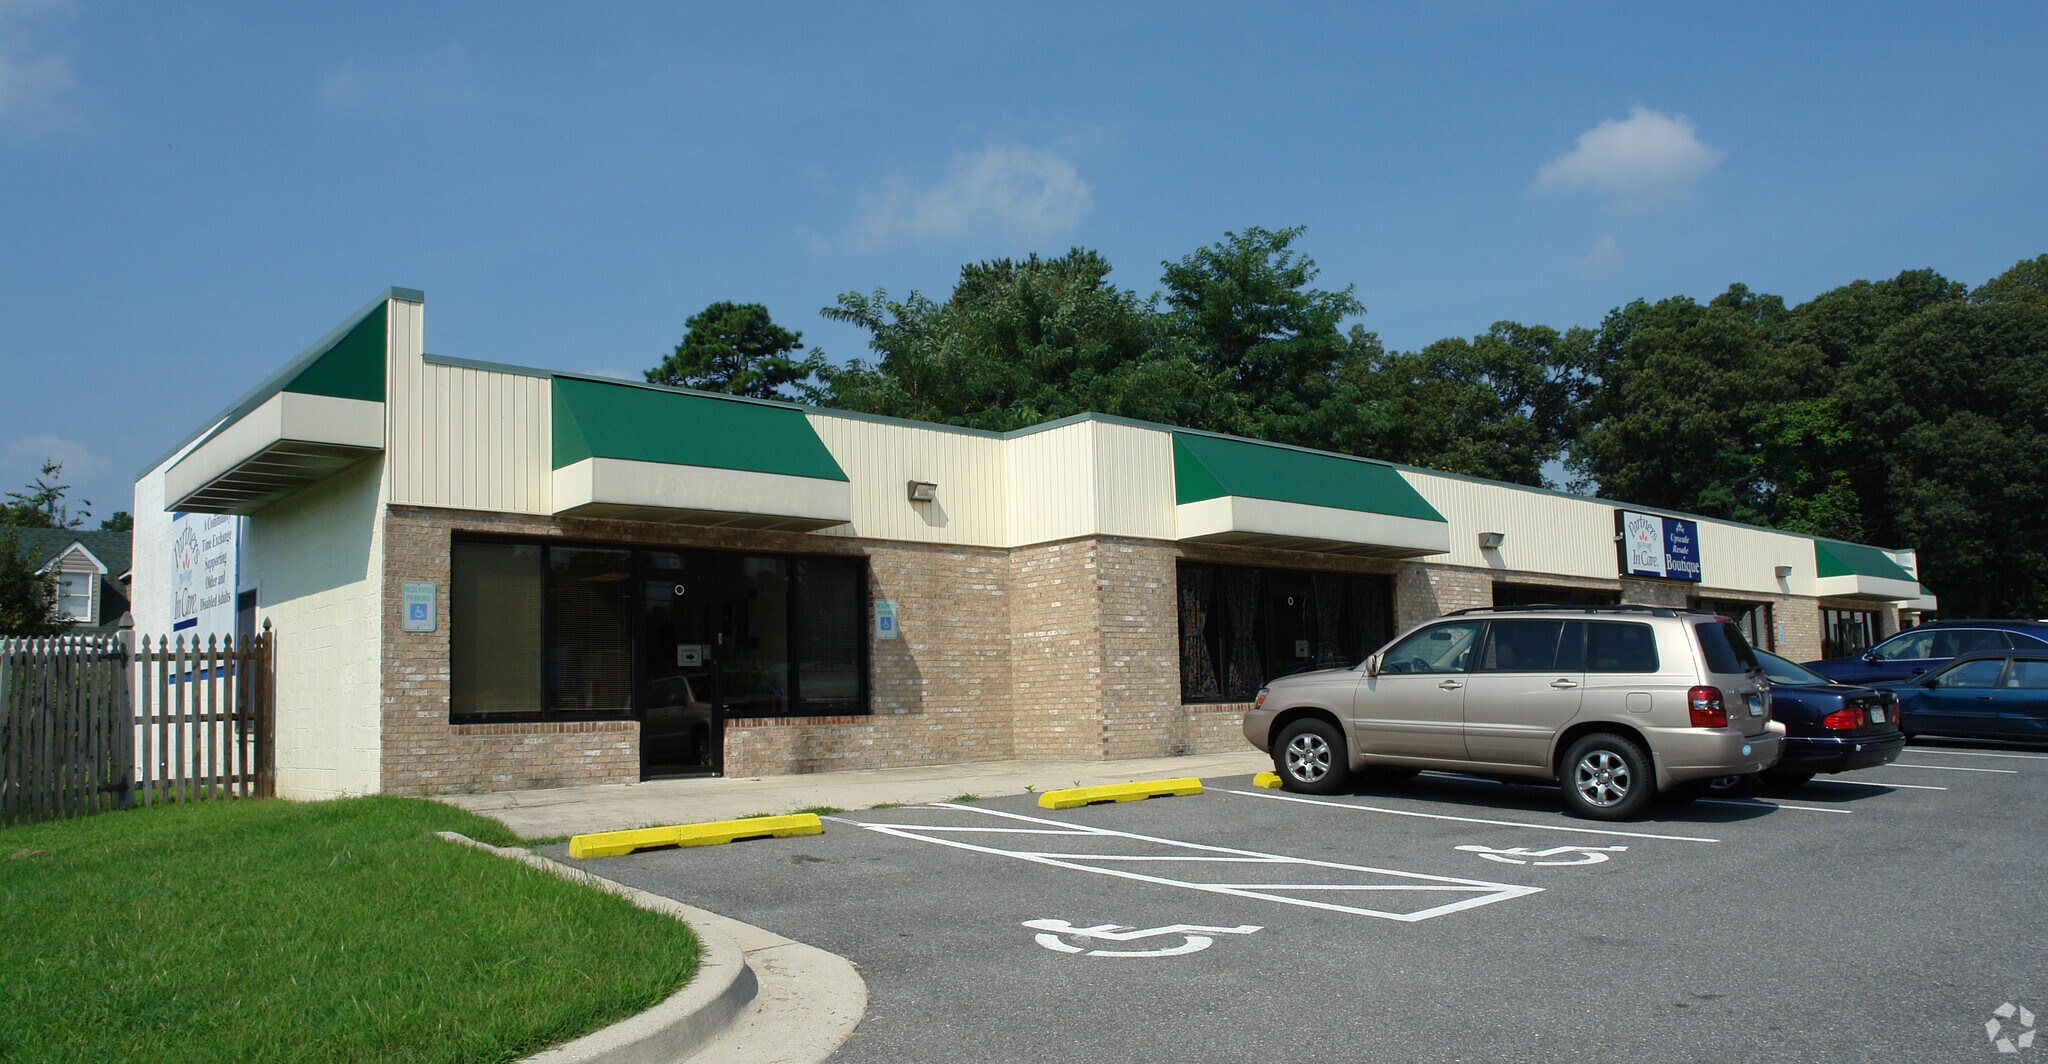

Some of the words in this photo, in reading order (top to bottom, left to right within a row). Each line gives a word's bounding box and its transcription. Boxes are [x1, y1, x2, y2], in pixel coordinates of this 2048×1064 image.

[1628, 515, 1658, 541] Partners
[1670, 533, 1689, 544] Upscale
[174, 519, 200, 572] Partners
[202, 538, 211, 552] Time
[212, 530, 232, 548] Exchange
[204, 551, 228, 571] Supporting
[1633, 549, 1640, 565] In
[1665, 553, 1700, 578] Boutique
[205, 575, 217, 590] Older
[217, 570, 226, 585] and
[174, 590, 181, 620] In
[200, 592, 217, 612] Disabled
[217, 589, 231, 606] Adults
